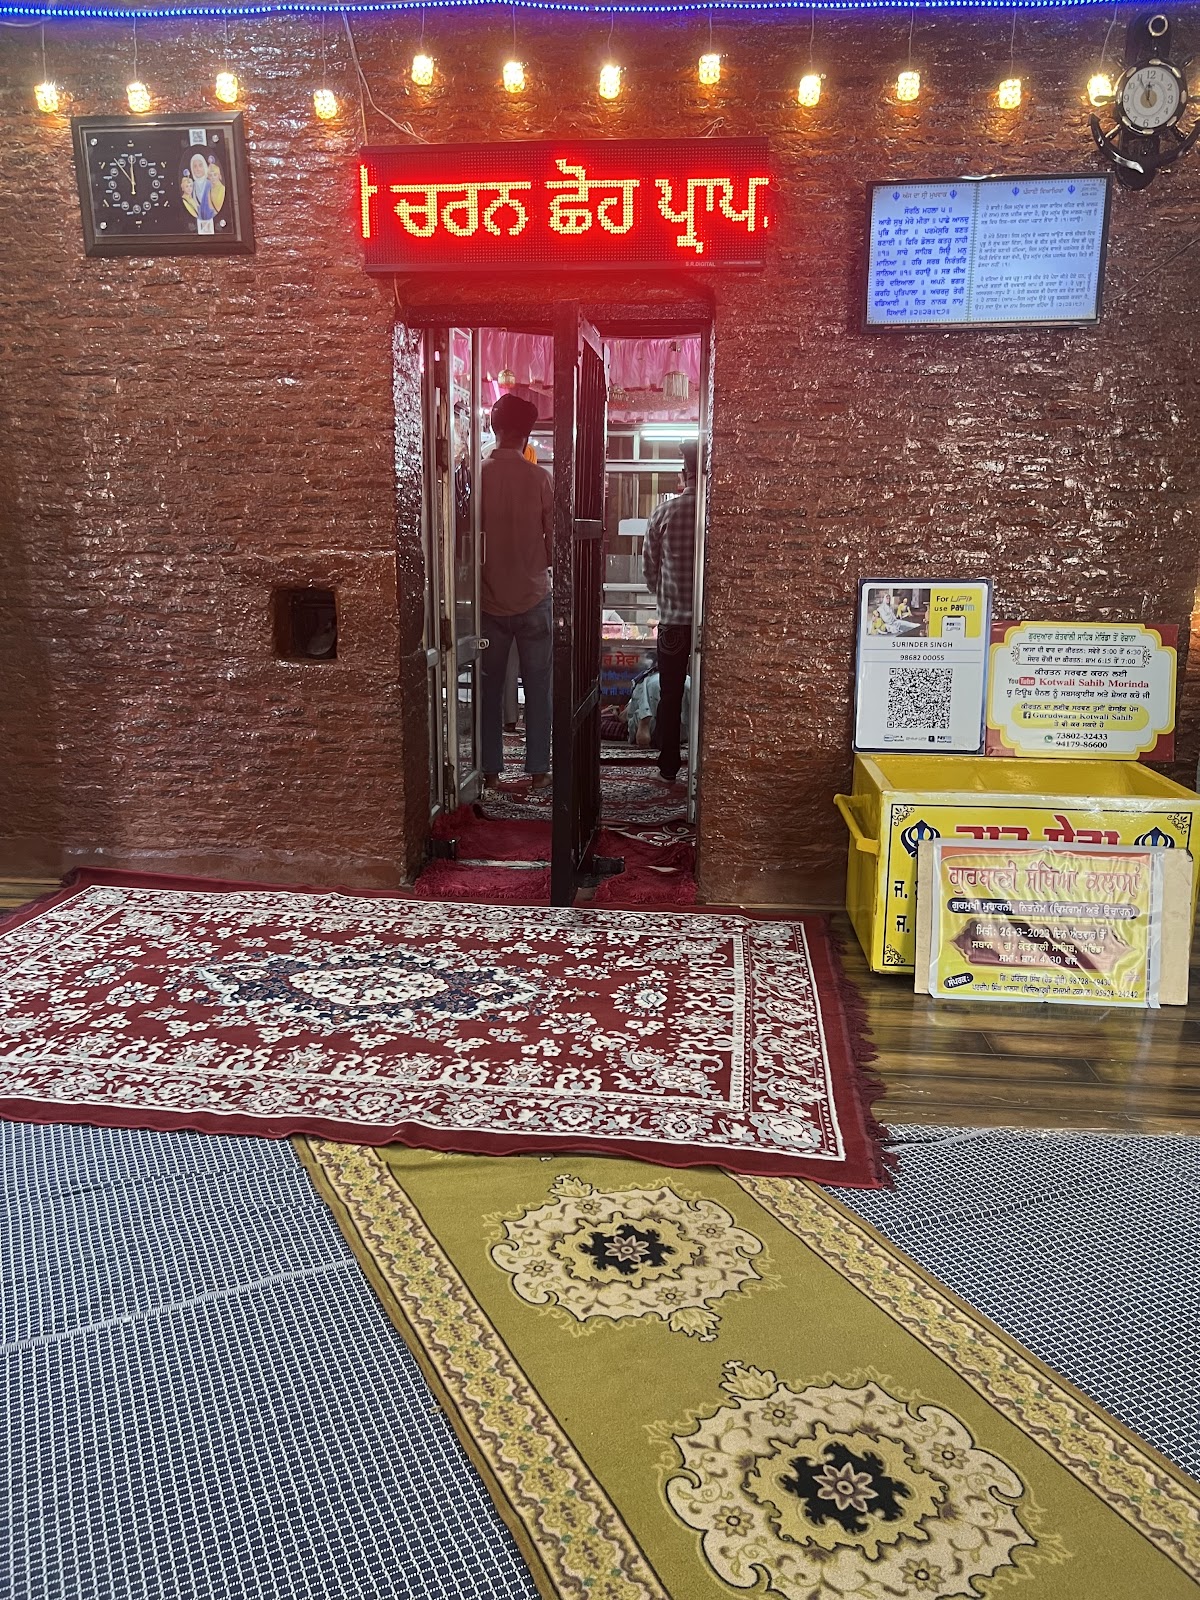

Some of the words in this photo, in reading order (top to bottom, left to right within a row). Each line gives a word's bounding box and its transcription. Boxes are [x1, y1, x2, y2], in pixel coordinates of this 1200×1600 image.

[389, 181, 532, 238] ਚਰਨ
[655, 177, 769, 254] ਪ੍ਰਾਪ
[1008, 676, 1035, 686] YouTube
[1039, 678, 1075, 686] Kotwali
[1078, 678, 1104, 687] Sahib
[1108, 679, 1149, 688] Morinda
[1097, 689, 1109, 698] ਅਤੇ
[1056, 732, 1108, 740] 73802-32433
[1055, 741, 1108, 749] 94179-86600
[948, 860, 1019, 895] ਗੁਰਬਾਣੀ
[951, 900, 980, 912] ਗੁਰਮੁਖੀ
[1018, 902, 1046, 913] ਨਿਤਨੇਮ
[1086, 904, 1100, 915] ਅਤੇ
[999, 928, 1050, 939] 26-3-2023
